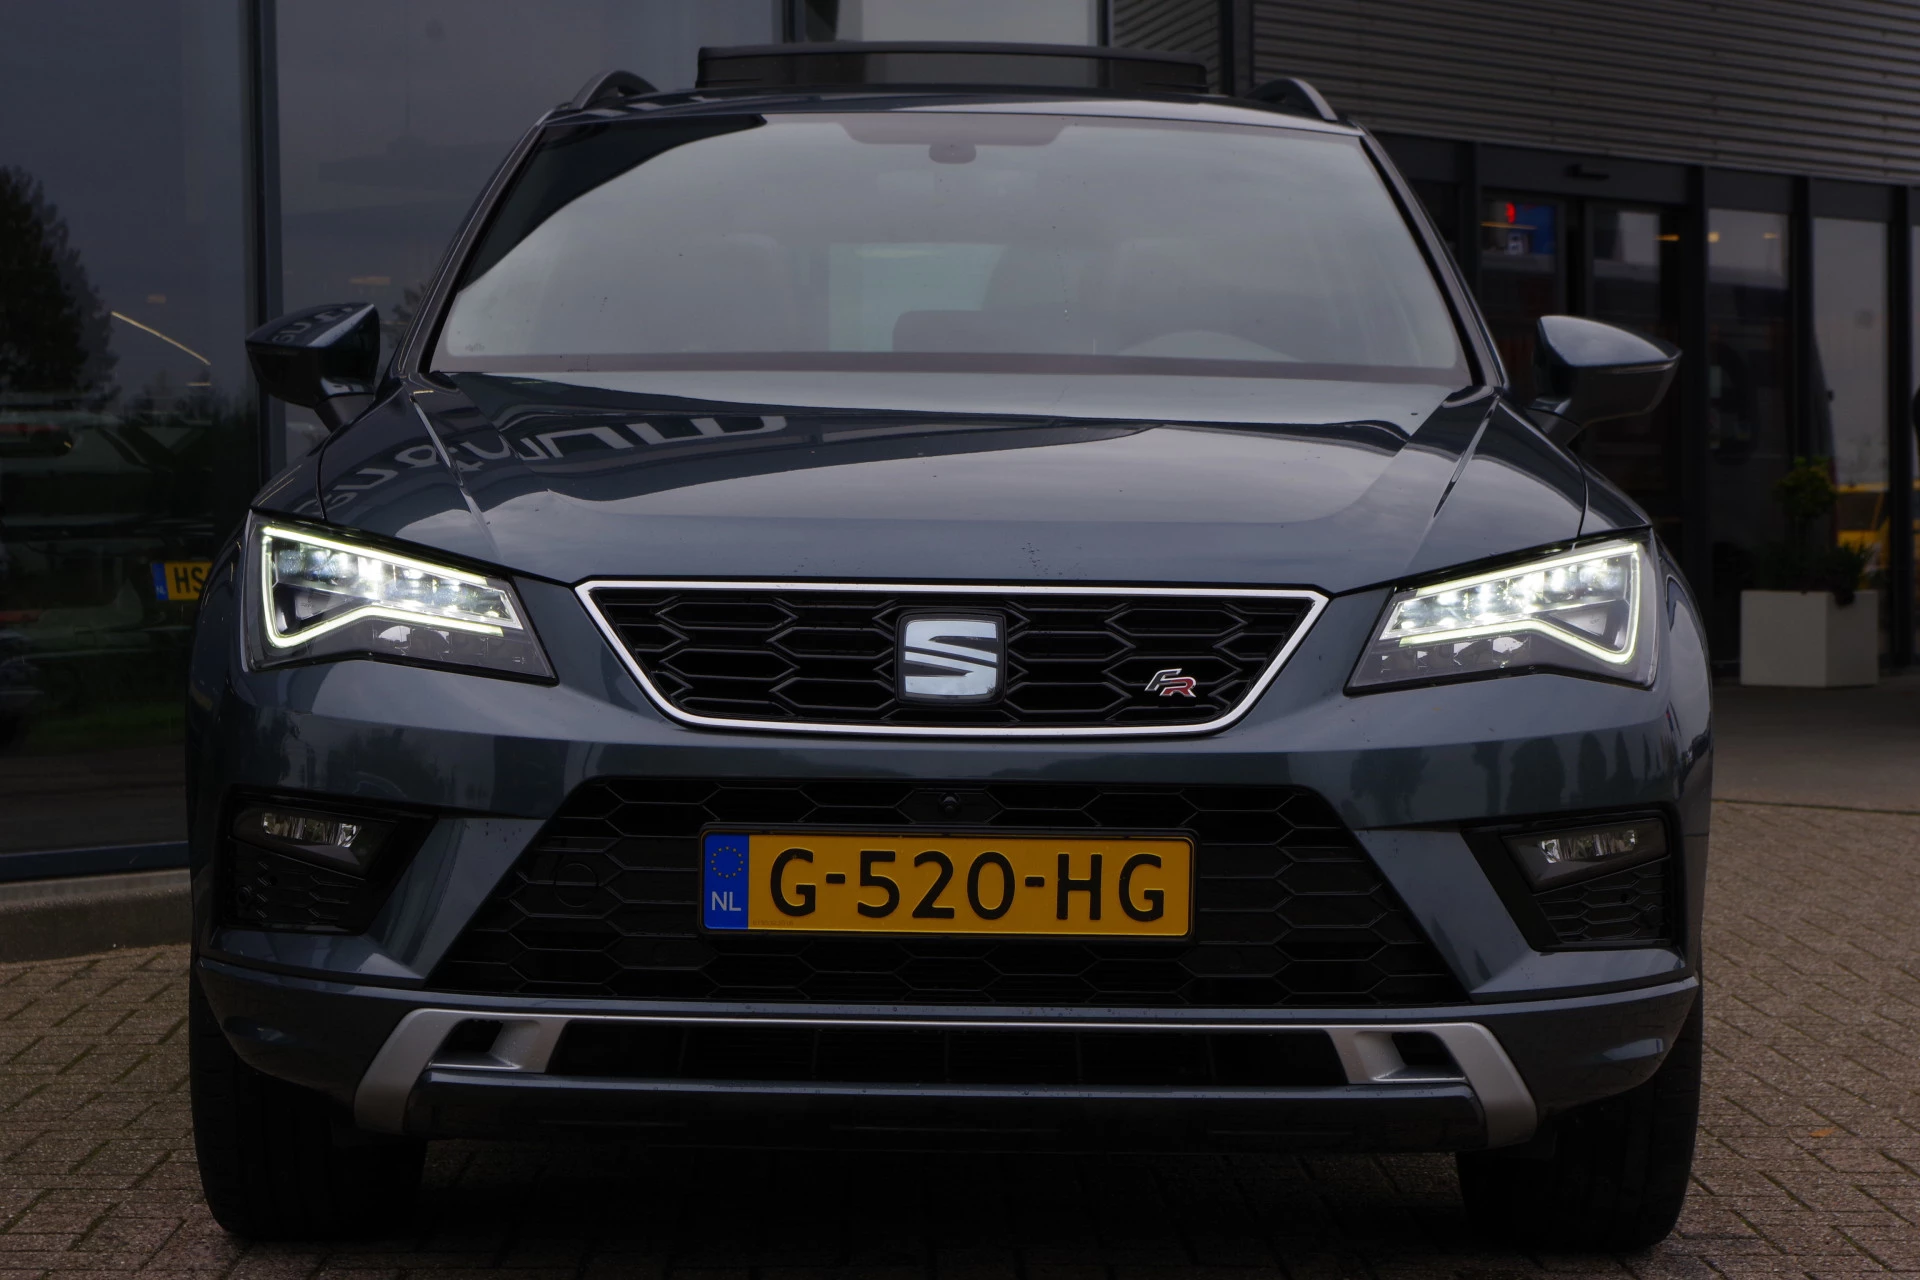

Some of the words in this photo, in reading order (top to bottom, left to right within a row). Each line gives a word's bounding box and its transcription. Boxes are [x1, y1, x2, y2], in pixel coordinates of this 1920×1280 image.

[174, 567, 210, 594] HS
[1143, 667, 1198, 698] FR
[769, 847, 1165, 922] G-520-HG
[711, 891, 742, 912] NL
